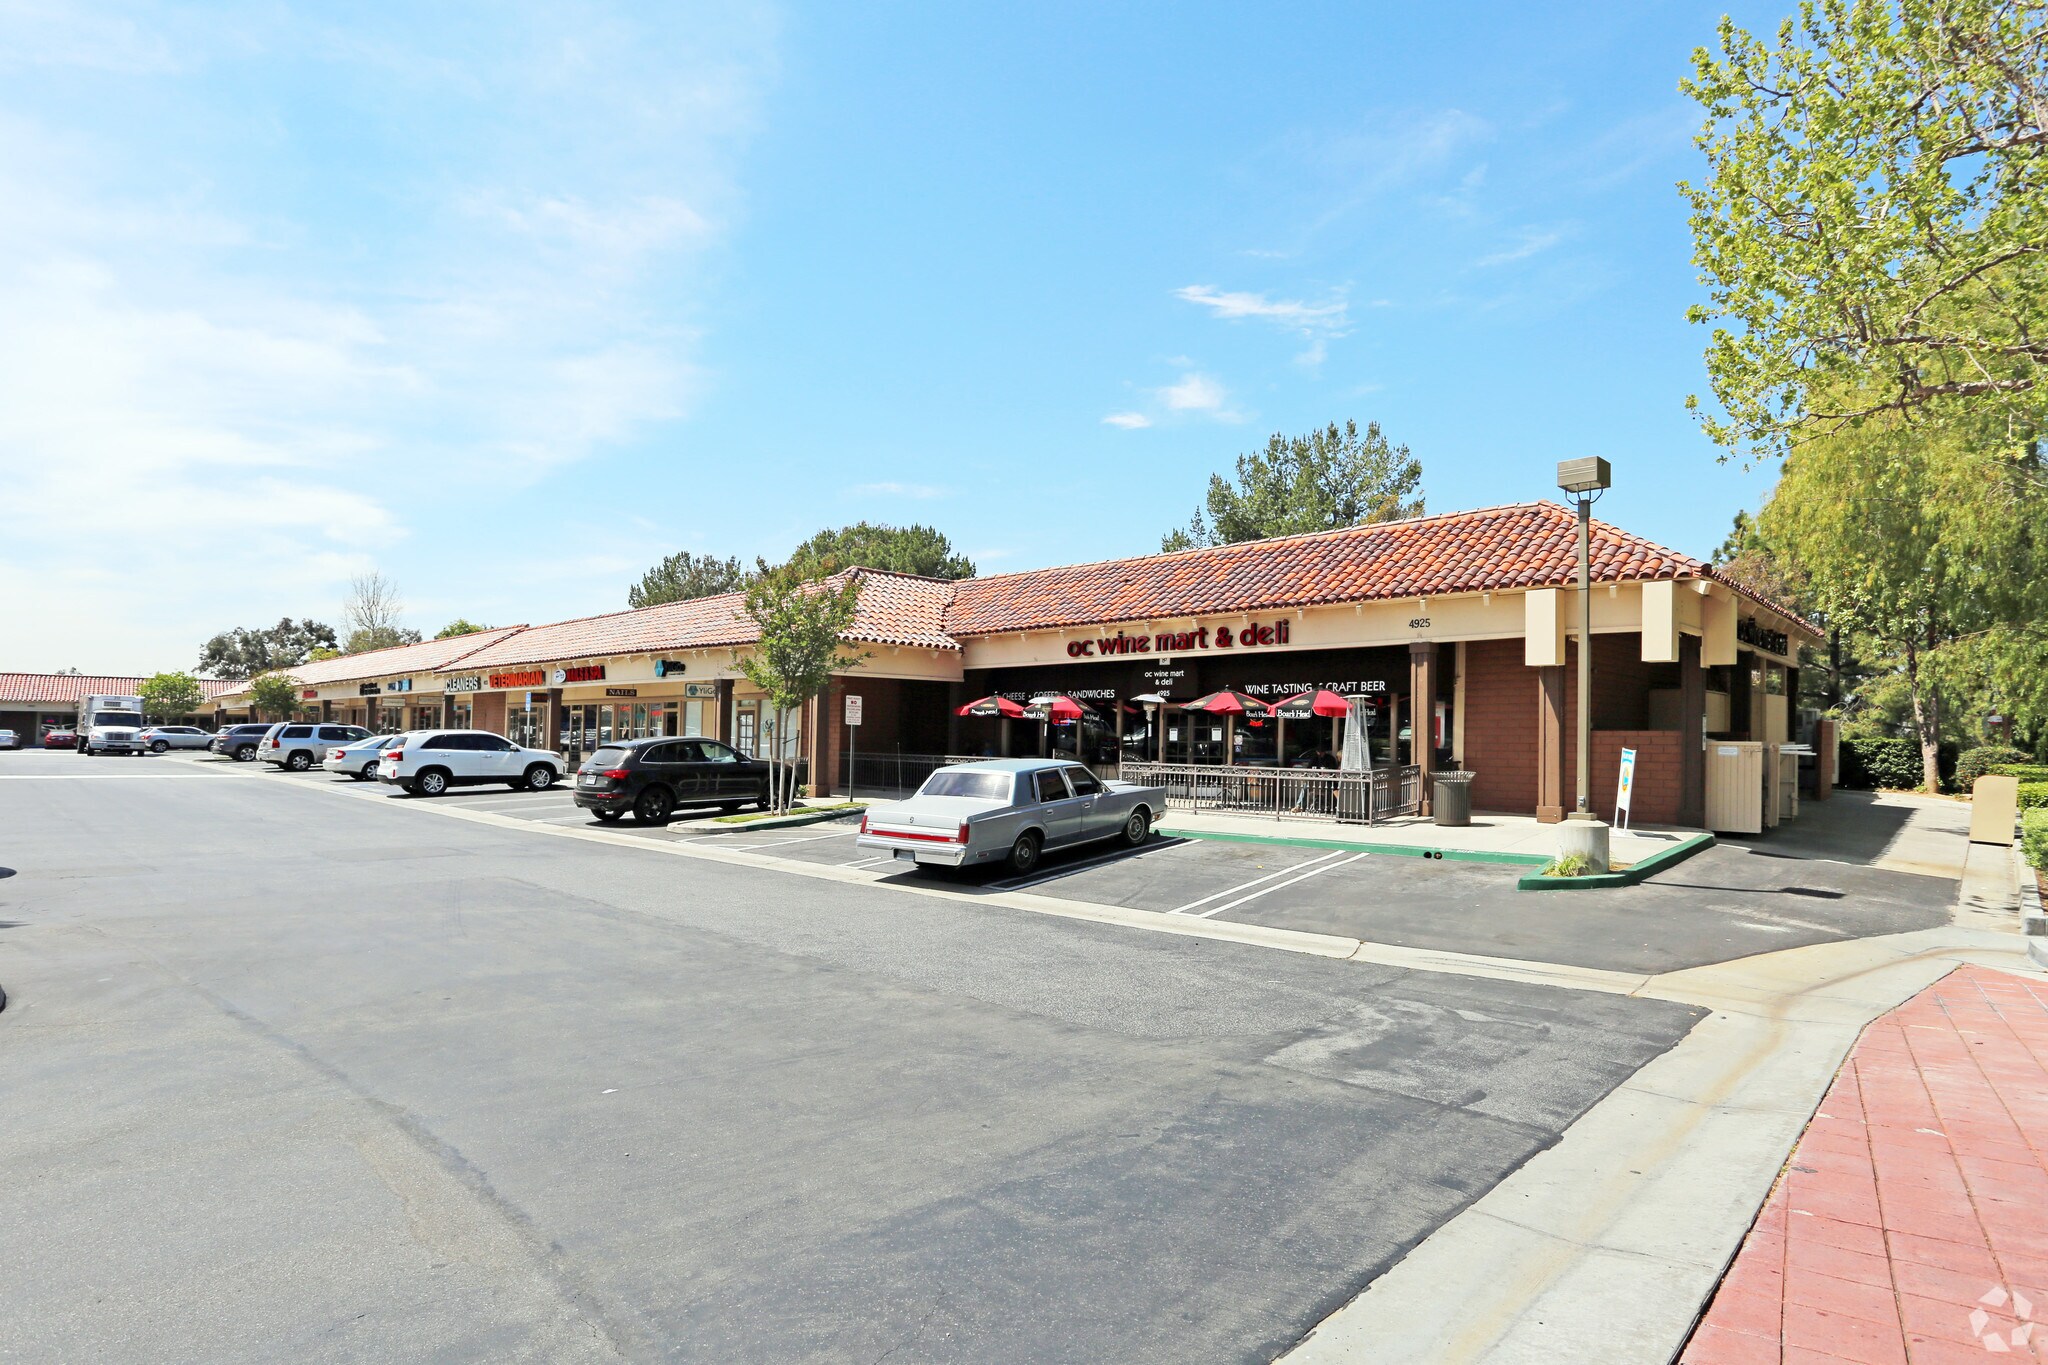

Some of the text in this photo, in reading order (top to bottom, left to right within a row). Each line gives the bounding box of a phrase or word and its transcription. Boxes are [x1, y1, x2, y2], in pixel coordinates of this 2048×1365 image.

[1408, 618, 1431, 629] 4925
[1066, 618, 1290, 657] oc wine mart & deli
[489, 671, 545, 688] VETERINARIAN
[1153, 670, 1169, 678] wine
[1170, 669, 1185, 677] mart
[445, 676, 481, 693] CLEANERS
[1160, 677, 1173, 686] deli
[1325, 682, 1357, 692] CRAFT
[1360, 680, 1386, 691] BEER
[1067, 688, 1115, 700] SANDWICHES
[1245, 684, 1270, 695] WINE
[1271, 682, 1313, 694] TASTING
[1002, 691, 1026, 701] CHEESE
